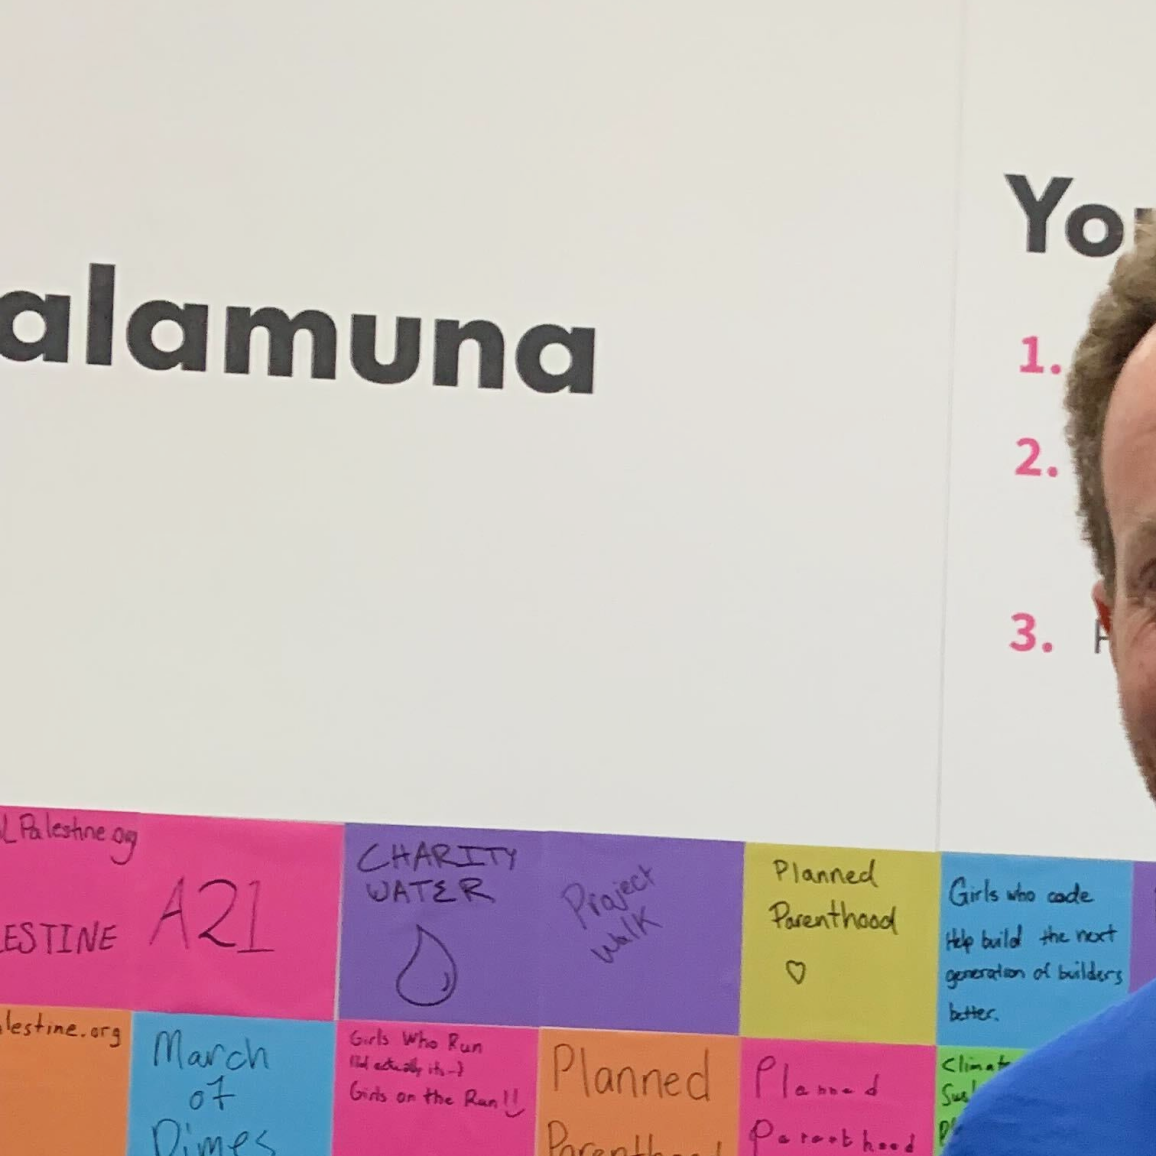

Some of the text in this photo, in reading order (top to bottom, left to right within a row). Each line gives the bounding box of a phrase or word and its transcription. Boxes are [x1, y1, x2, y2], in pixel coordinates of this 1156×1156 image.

[1003, 173, 1153, 258] Yo
[1019, 337, 1062, 375] 1.
[1015, 438, 1058, 478] 2.
[1010, 613, 1053, 653] 3.
[357, 841, 518, 872] CHARITY
[773, 859, 878, 887] Planned
[366, 876, 496, 904] WATER
[949, 877, 999, 907] Girls
[149, 876, 275, 953] A21
[769, 900, 898, 935] Parenthood
[0, 921, 117, 954] ESTINE
[982, 924, 1023, 949] build
[1039, 926, 1070, 945] the
[1076, 924, 1117, 943] next
[945, 961, 1123, 989] generation of builders
[0, 1009, 121, 1048] lestine.org
[153, 1029, 270, 1071] March
[552, 1043, 711, 1103] Planned
